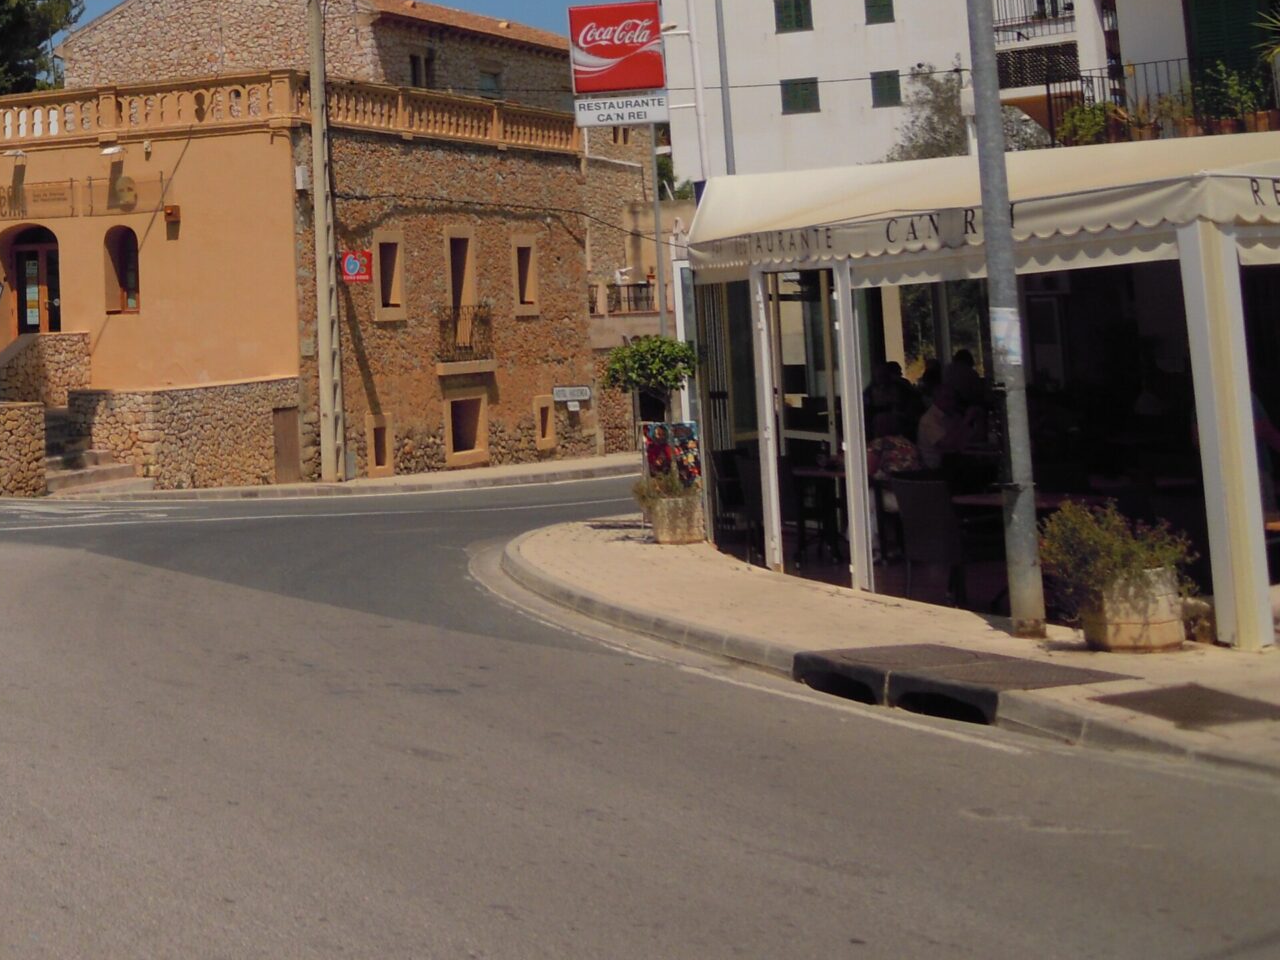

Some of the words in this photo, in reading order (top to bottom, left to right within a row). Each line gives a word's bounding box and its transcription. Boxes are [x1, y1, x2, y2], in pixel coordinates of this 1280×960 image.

[579, 19, 654, 48] Coca-Cola
[578, 98, 665, 111] RESTAURANTE
[628, 111, 647, 120] REI
[711, 227, 833, 257] TAURANTE
[963, 203, 1016, 235] RI
